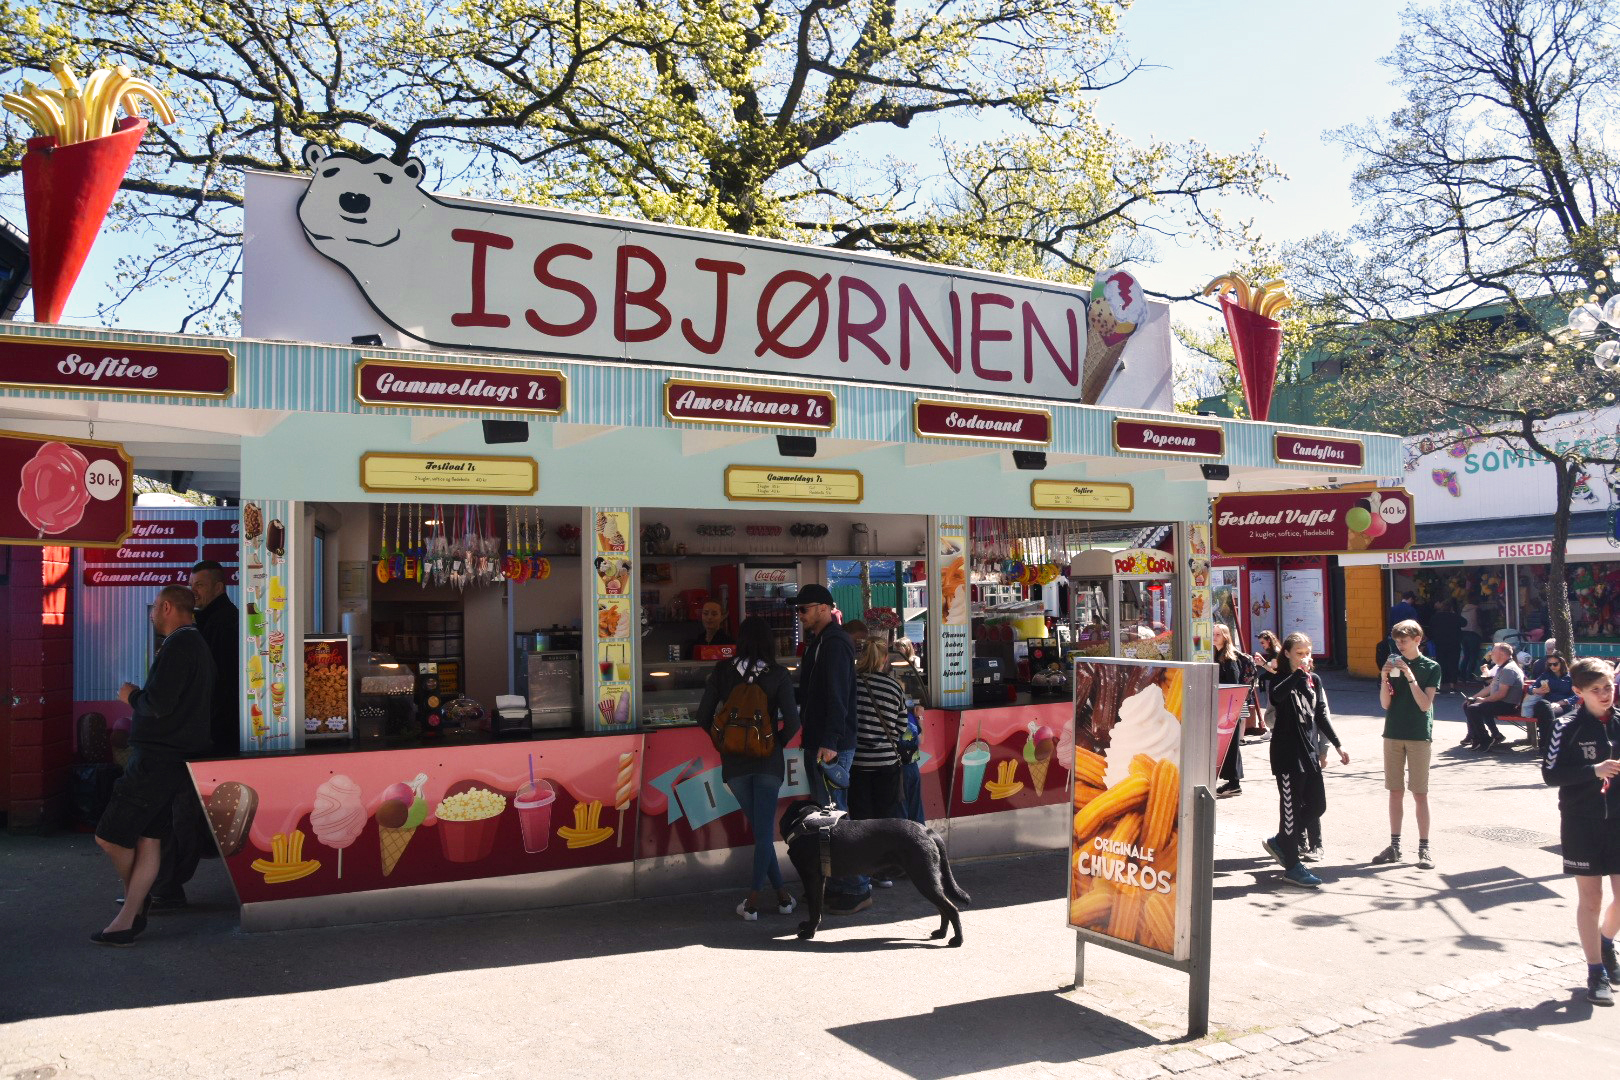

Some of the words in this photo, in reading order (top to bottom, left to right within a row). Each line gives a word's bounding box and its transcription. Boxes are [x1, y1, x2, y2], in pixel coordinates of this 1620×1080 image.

[450, 227, 1081, 387] ISBJØRNEN
[57, 353, 159, 381] Softice
[376, 372, 520, 402] Gammeldags
[528, 381, 547, 401] Is
[675, 389, 800, 417] Amerikaner
[806, 398, 825, 418] Is
[945, 411, 1024, 433] Sodavand
[1143, 428, 1197, 447] Popcorn
[1292, 441, 1345, 460] Candyfloss
[425, 461, 465, 471] Festival
[89, 472, 105, 486] 30
[108, 474, 120, 487] kr
[767, 472, 814, 484] Gammeldags
[1218, 511, 1282, 526] Festival
[1285, 508, 1337, 527] Vaffel
[1382, 507, 1395, 515] 40
[1397, 506, 1406, 515] kr
[132, 524, 175, 537] dyfloss
[1249, 530, 1255, 538] 2
[1255, 530, 1277, 540] kugler,
[1278, 530, 1302, 538] softice,
[116, 547, 165, 559] Churros
[1387, 549, 1445, 564] FISKEDAM
[1498, 541, 1567, 558] FISKEDA
[1115, 556, 1136, 573] POP
[1147, 556, 1175, 573] CORN
[92, 571, 172, 582] Gammeldags
[176, 570, 188, 582] Is
[1580, 745, 1597, 760] 13
[1093, 836, 1155, 863] ORIGINALE
[1077, 851, 1172, 894] CHURROS
